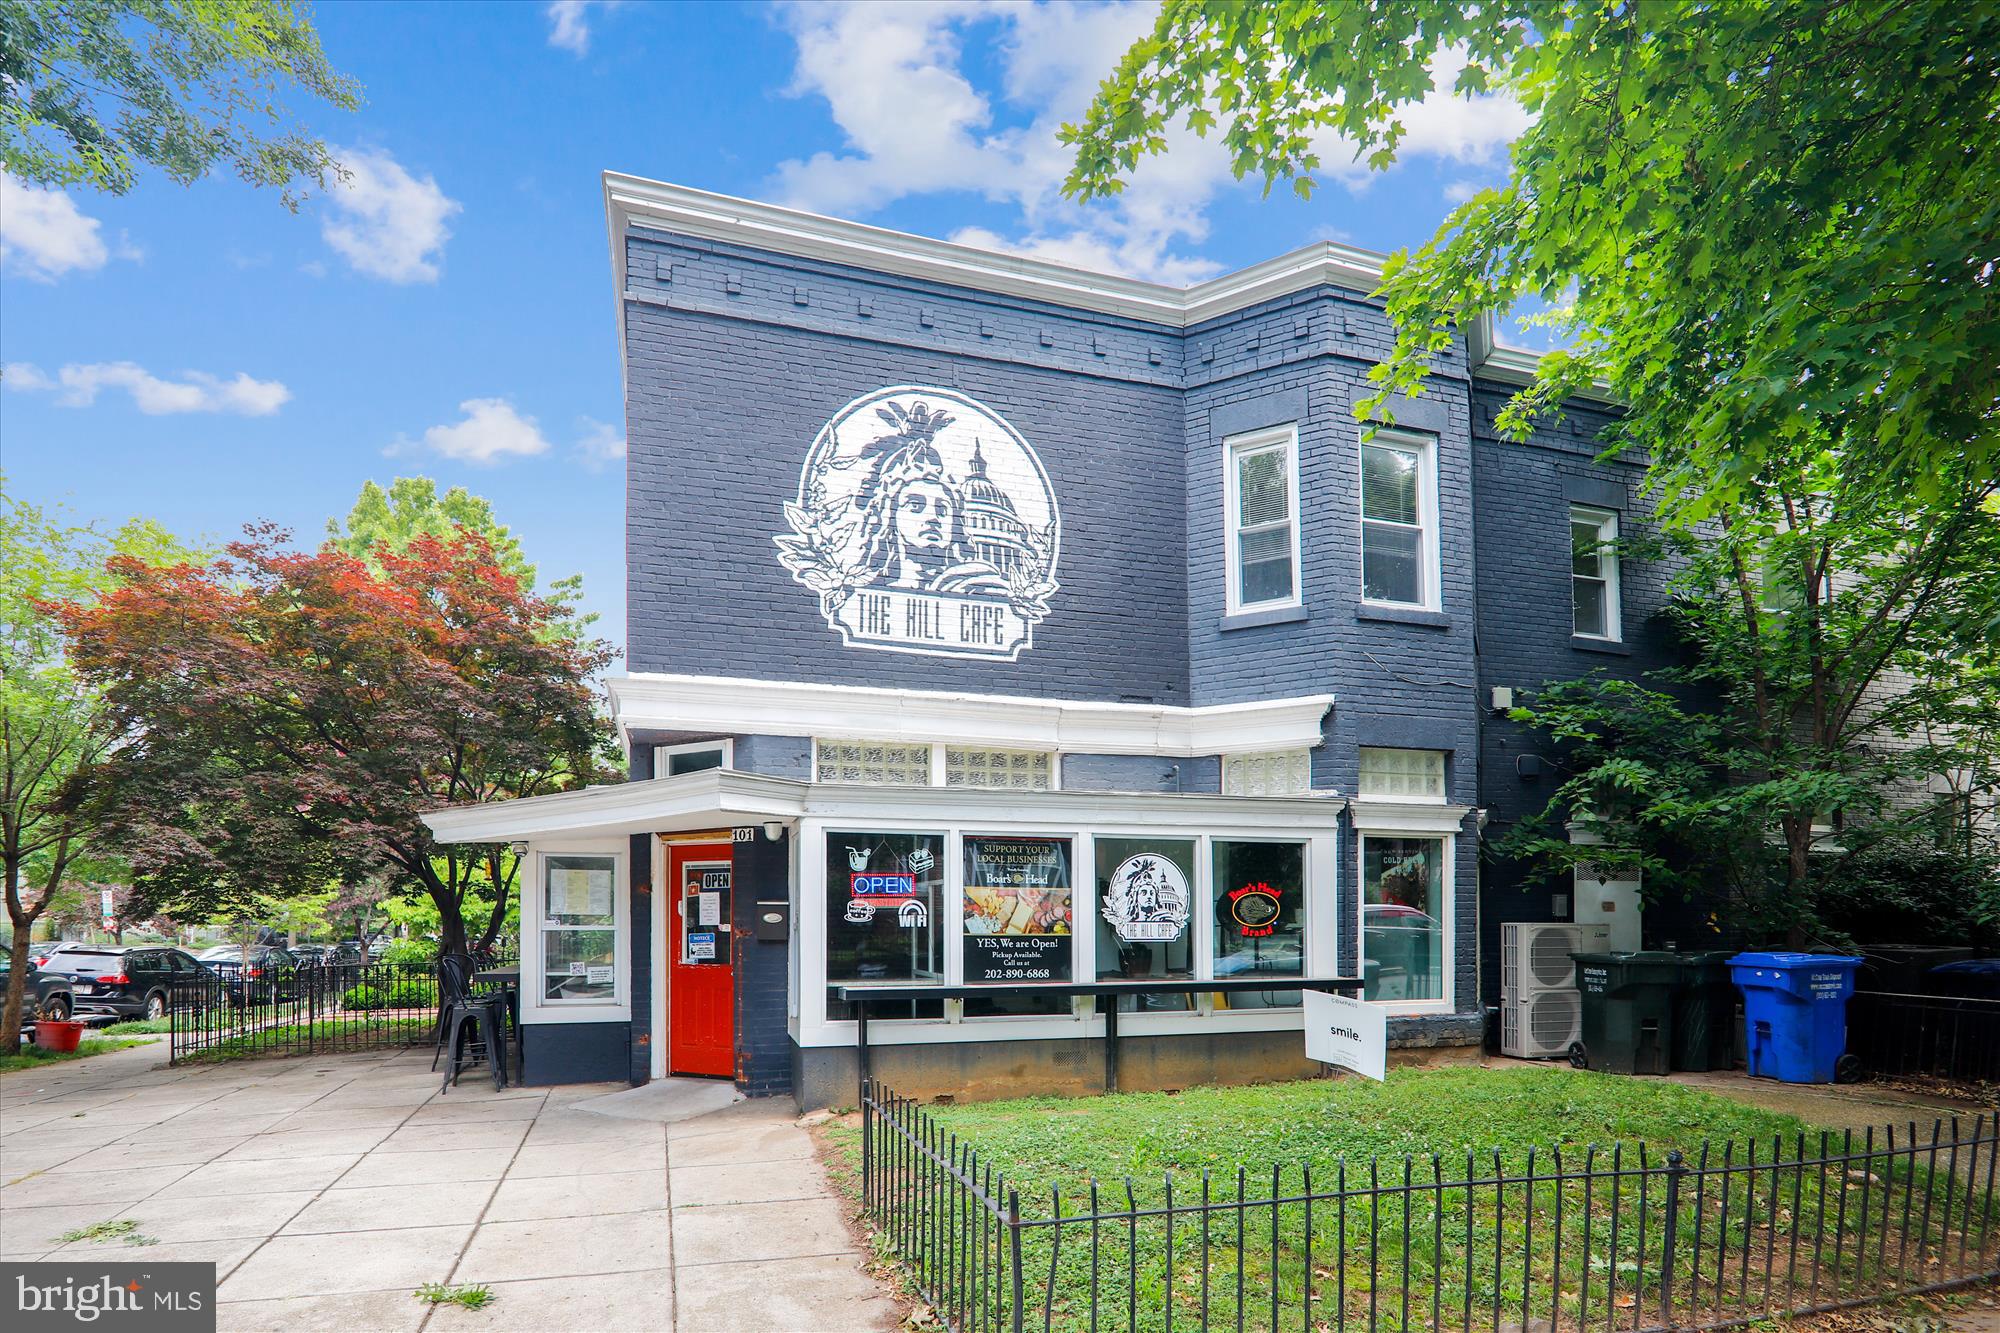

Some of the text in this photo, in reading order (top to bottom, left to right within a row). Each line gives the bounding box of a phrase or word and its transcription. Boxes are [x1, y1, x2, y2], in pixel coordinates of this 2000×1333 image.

[857, 593, 1004, 645] THE HILL CAFE
[733, 829, 753, 841] 101
[983, 844, 1050, 855] SUPPORT YOUR
[977, 854, 1057, 865] LOCAL BUSINESSES
[1383, 856, 1401, 864] COLD
[705, 873, 729, 888] OPEN
[986, 873, 1048, 885] Boar's Head
[854, 877, 912, 894] OPEN
[1126, 923, 1172, 937] THE HILL CAFE
[1241, 924, 1273, 937] Brand
[976, 938, 1000, 950] YES,
[1000, 938, 1014, 948] We
[1031, 938, 1058, 951] Open!
[992, 952, 1012, 960] Pickup
[984, 969, 1050, 979] 202-890-6868
[1331, 997, 1358, 1009] COMPASS
[1330, 1026, 1362, 1043] smile.
